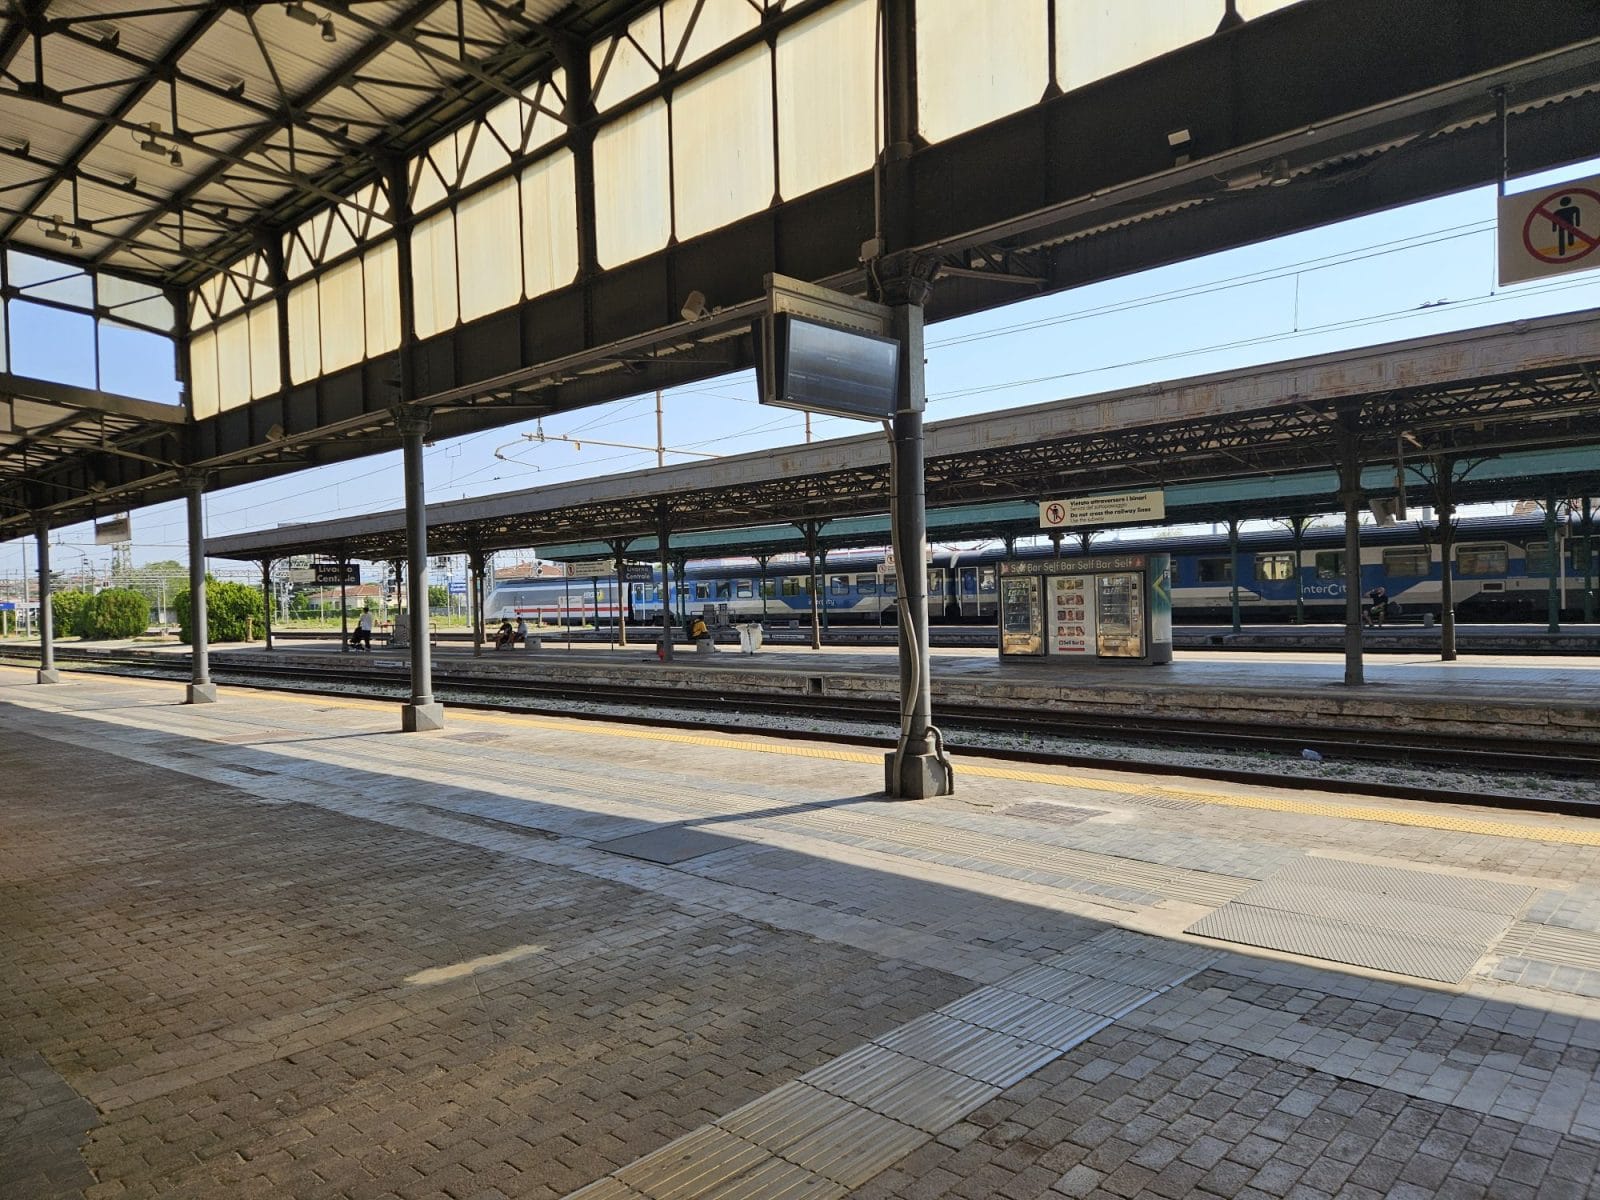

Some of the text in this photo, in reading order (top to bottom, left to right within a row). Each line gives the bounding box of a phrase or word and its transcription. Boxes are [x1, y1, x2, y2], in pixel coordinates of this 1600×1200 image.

[1090, 497, 1125, 505] attraversare
[1043, 561, 1059, 573] Self
[1061, 561, 1075, 571] Bar
[1077, 559, 1094, 570] Self
[1096, 559, 1111, 569] Bar
[1114, 558, 1132, 568] Self
